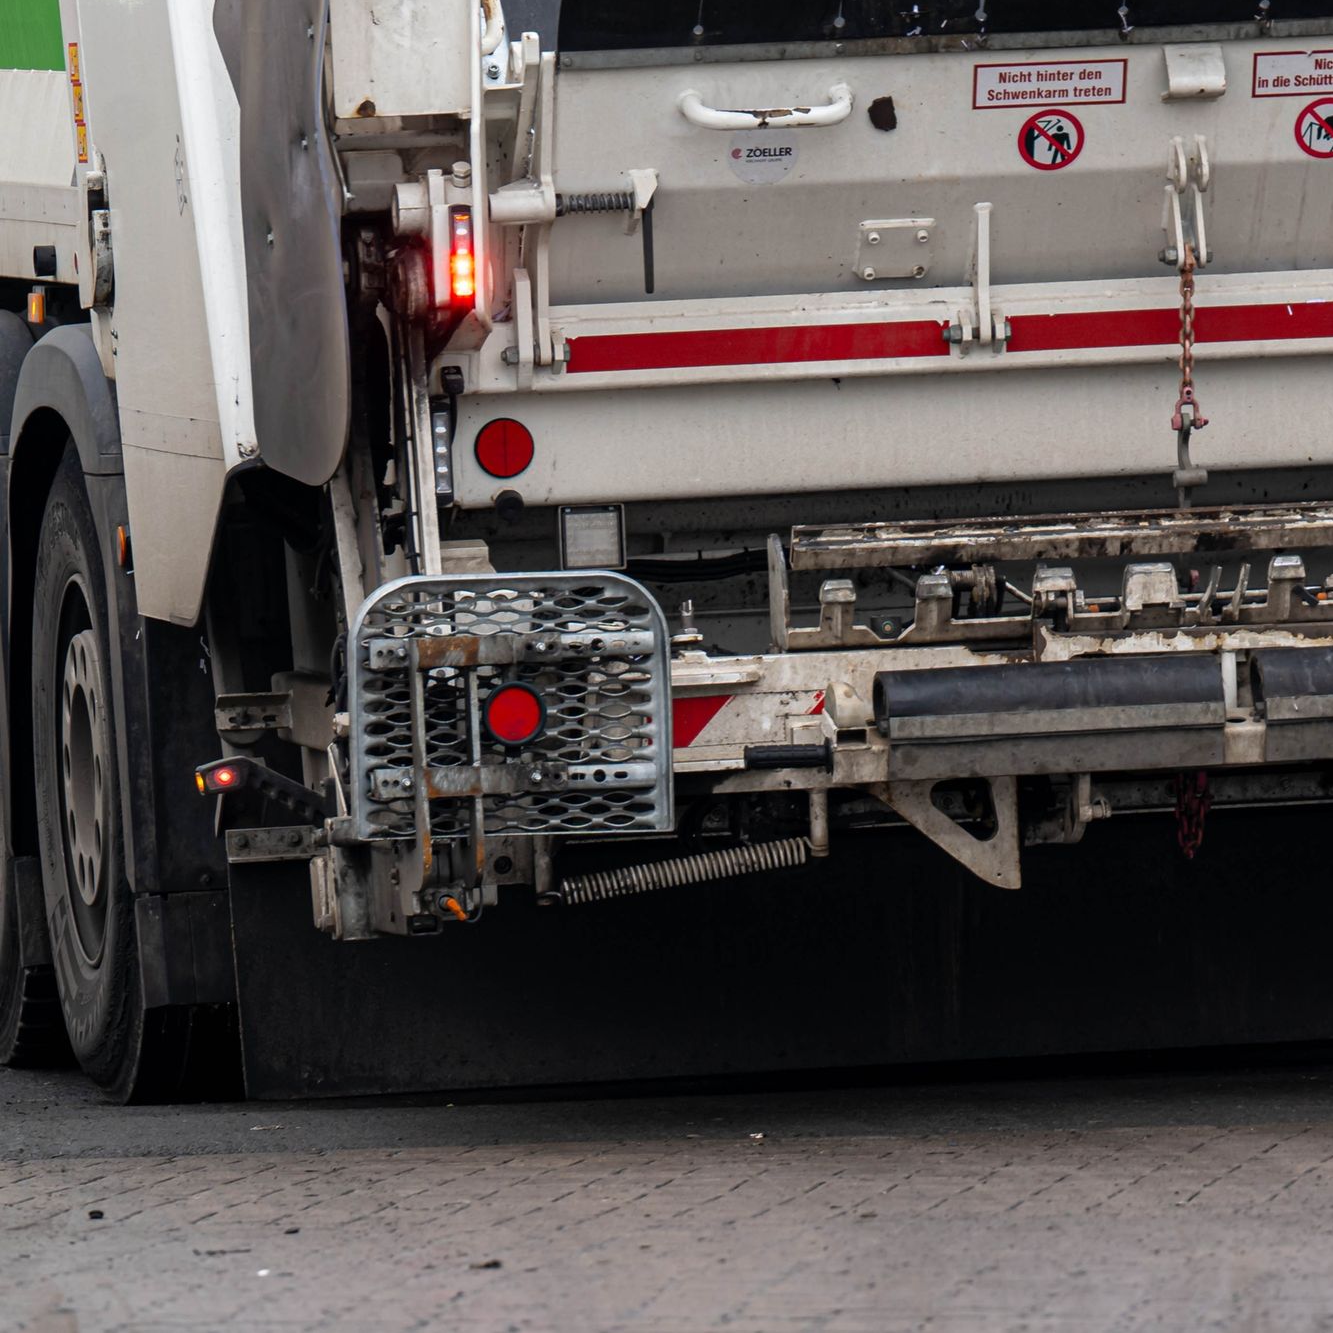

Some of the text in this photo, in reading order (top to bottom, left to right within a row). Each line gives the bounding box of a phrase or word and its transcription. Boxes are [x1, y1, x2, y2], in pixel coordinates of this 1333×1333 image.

[998, 68, 1102, 84] Nicht hinter den
[1257, 76, 1269, 89] in
[1272, 75, 1291, 88] die
[987, 86, 1112, 102] Schwenkarm treten
[746, 146, 792, 158] ZOELLER
